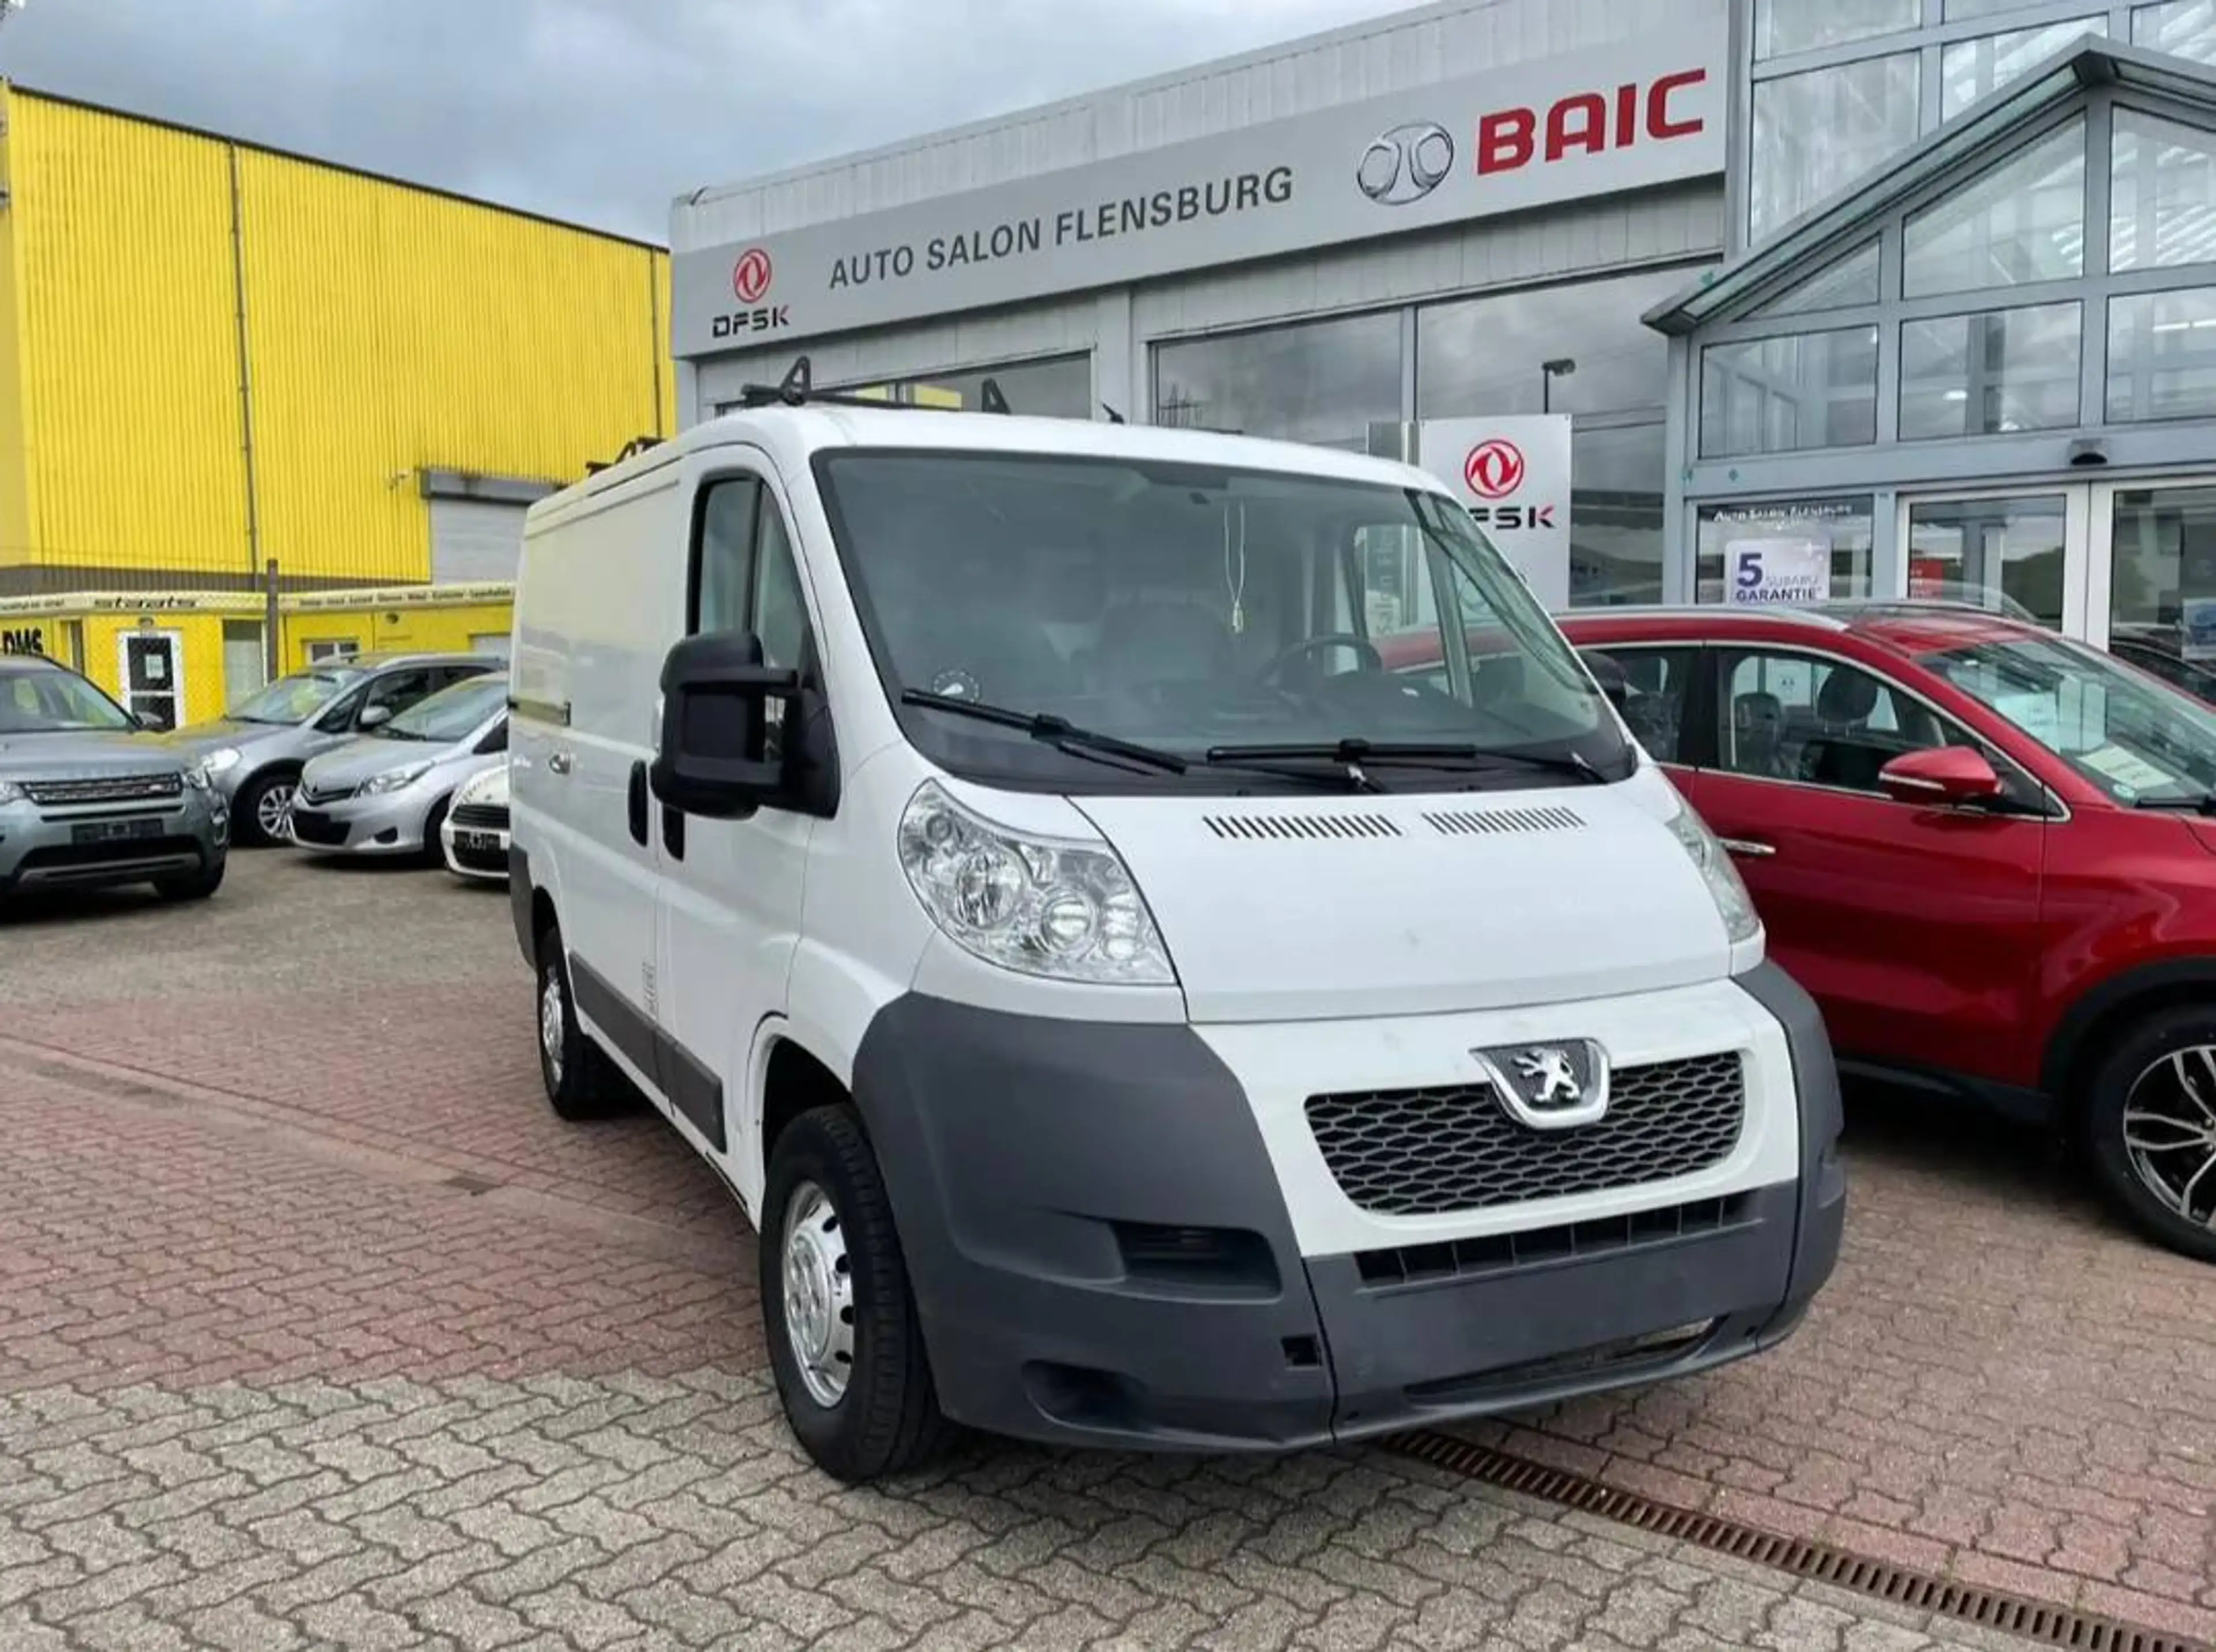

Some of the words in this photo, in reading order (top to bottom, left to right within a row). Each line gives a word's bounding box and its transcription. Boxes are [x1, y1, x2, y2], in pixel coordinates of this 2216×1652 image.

[1477, 68, 1706, 175] BAIC
[829, 246, 914, 289] AUTO
[926, 218, 1041, 271] SALON
[1055, 166, 1292, 245] FLENSBURG
[712, 305, 789, 337] DFSK
[1469, 507, 1556, 529] FSK
[1737, 553, 1763, 587] 5
[1736, 588, 1816, 601] GARANTIE
